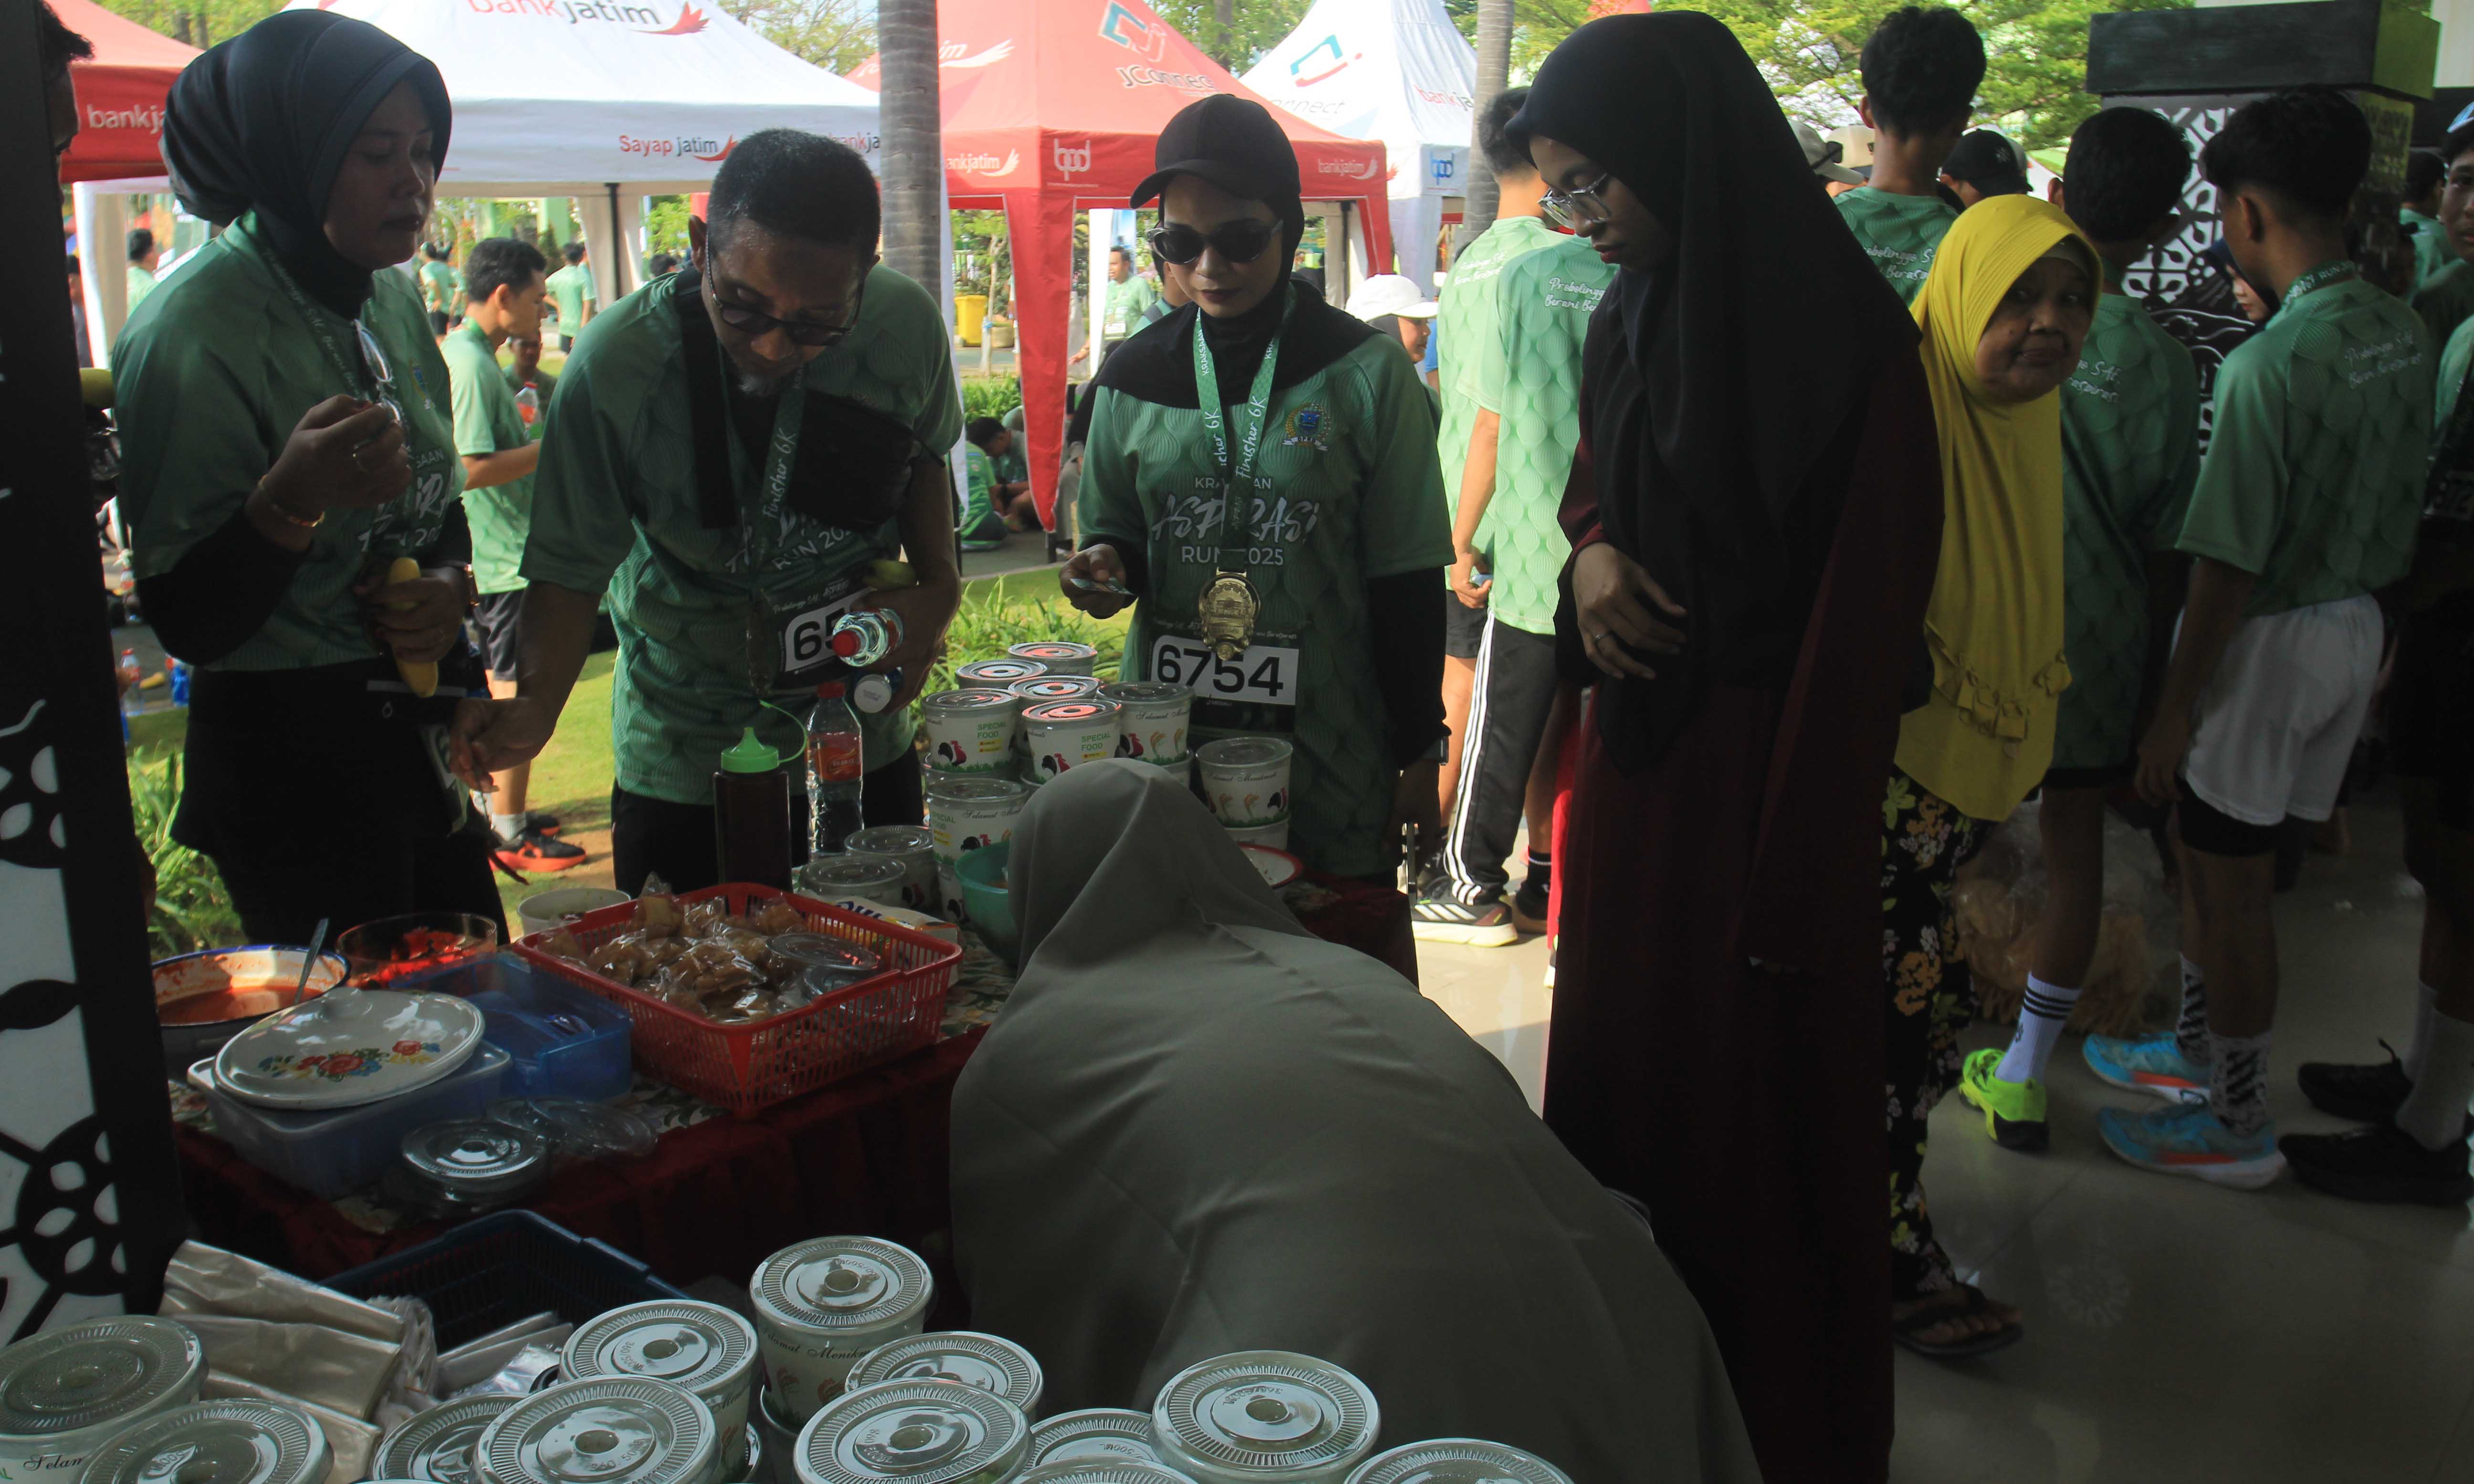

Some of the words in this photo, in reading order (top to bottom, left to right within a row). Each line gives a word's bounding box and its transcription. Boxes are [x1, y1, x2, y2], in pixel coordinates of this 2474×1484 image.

[618, 134, 672, 157] Sayap
[675, 136, 719, 157] jatim
[1317, 158, 1365, 177] bankjatim
[1204, 408, 1220, 429] 6K
[1235, 422, 1259, 479] Finisher
[1250, 395, 1268, 418] 6K
[762, 458, 788, 519] Finisher
[775, 427, 798, 454] 6K
[771, 537, 818, 571] RUN
[1157, 644, 1284, 697] 6754
[977, 721, 1007, 731] SPECIAL
[1081, 731, 1111, 742] SPECIAL
[1081, 742, 1103, 751] FOOD
[962, 808, 997, 820] Selamat
